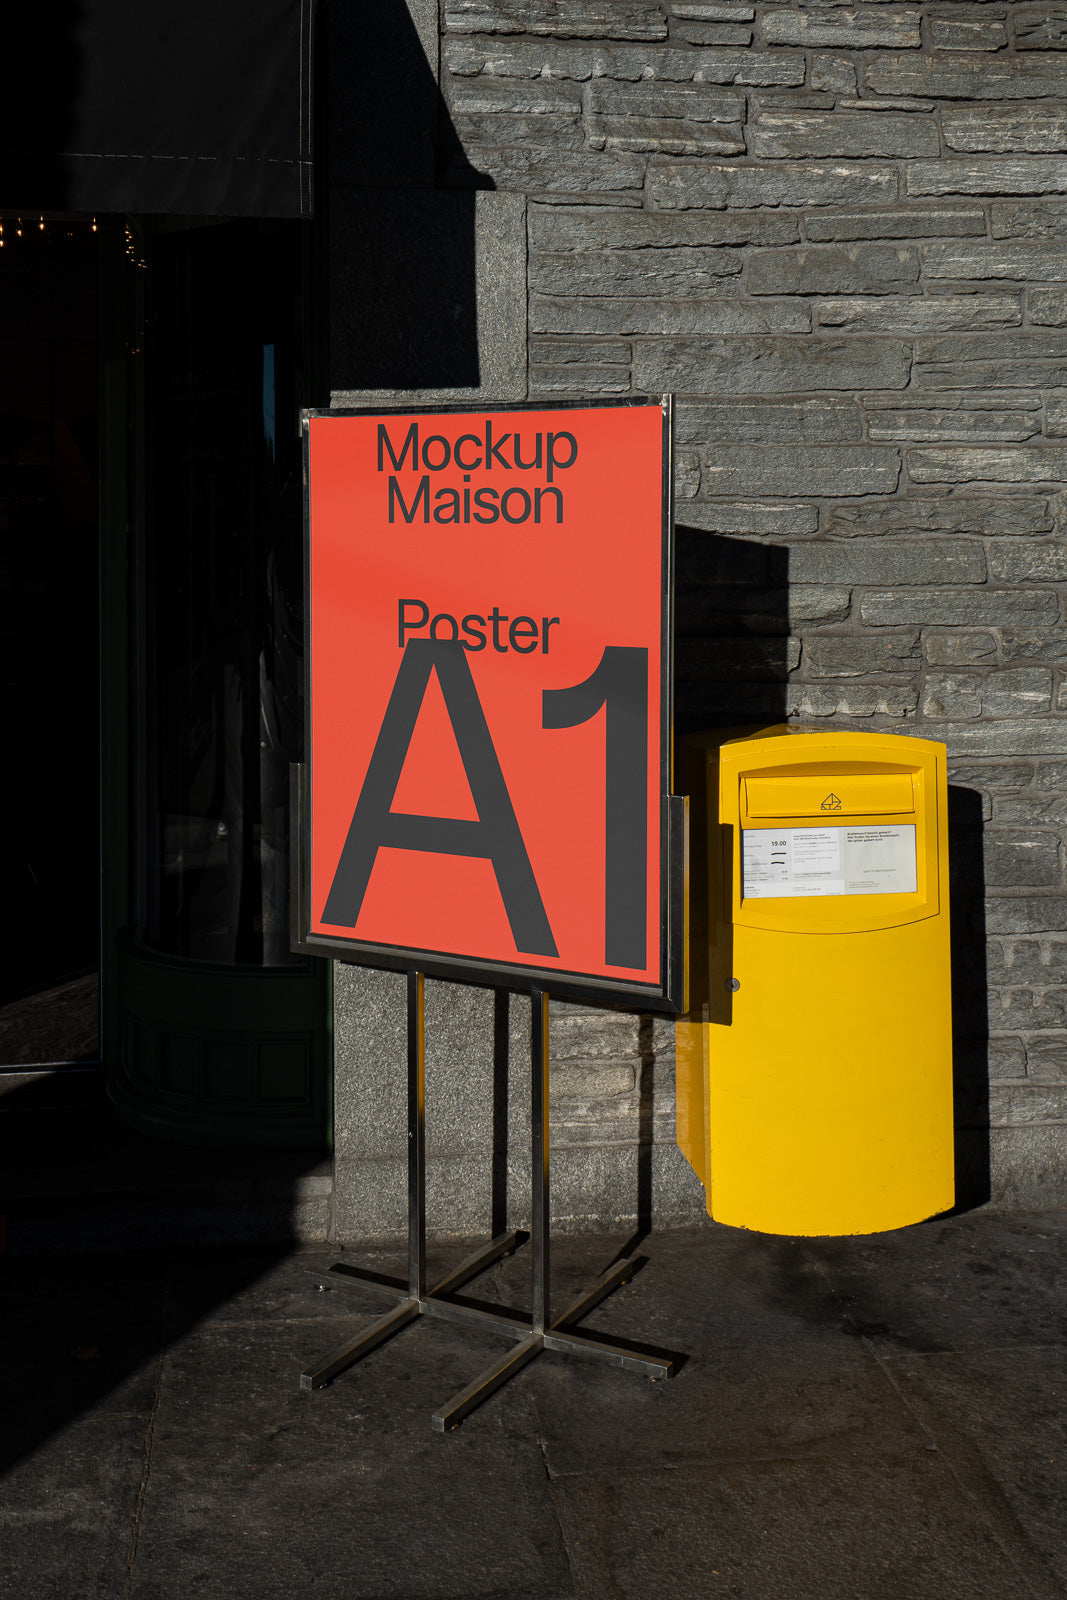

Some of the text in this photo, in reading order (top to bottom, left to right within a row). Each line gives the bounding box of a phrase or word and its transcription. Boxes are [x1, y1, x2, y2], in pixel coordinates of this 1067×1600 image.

[377, 420, 578, 482] Mockup
[388, 475, 563, 524] Maison
[398, 599, 560, 654] Poster
[320, 637, 648, 971] A1
